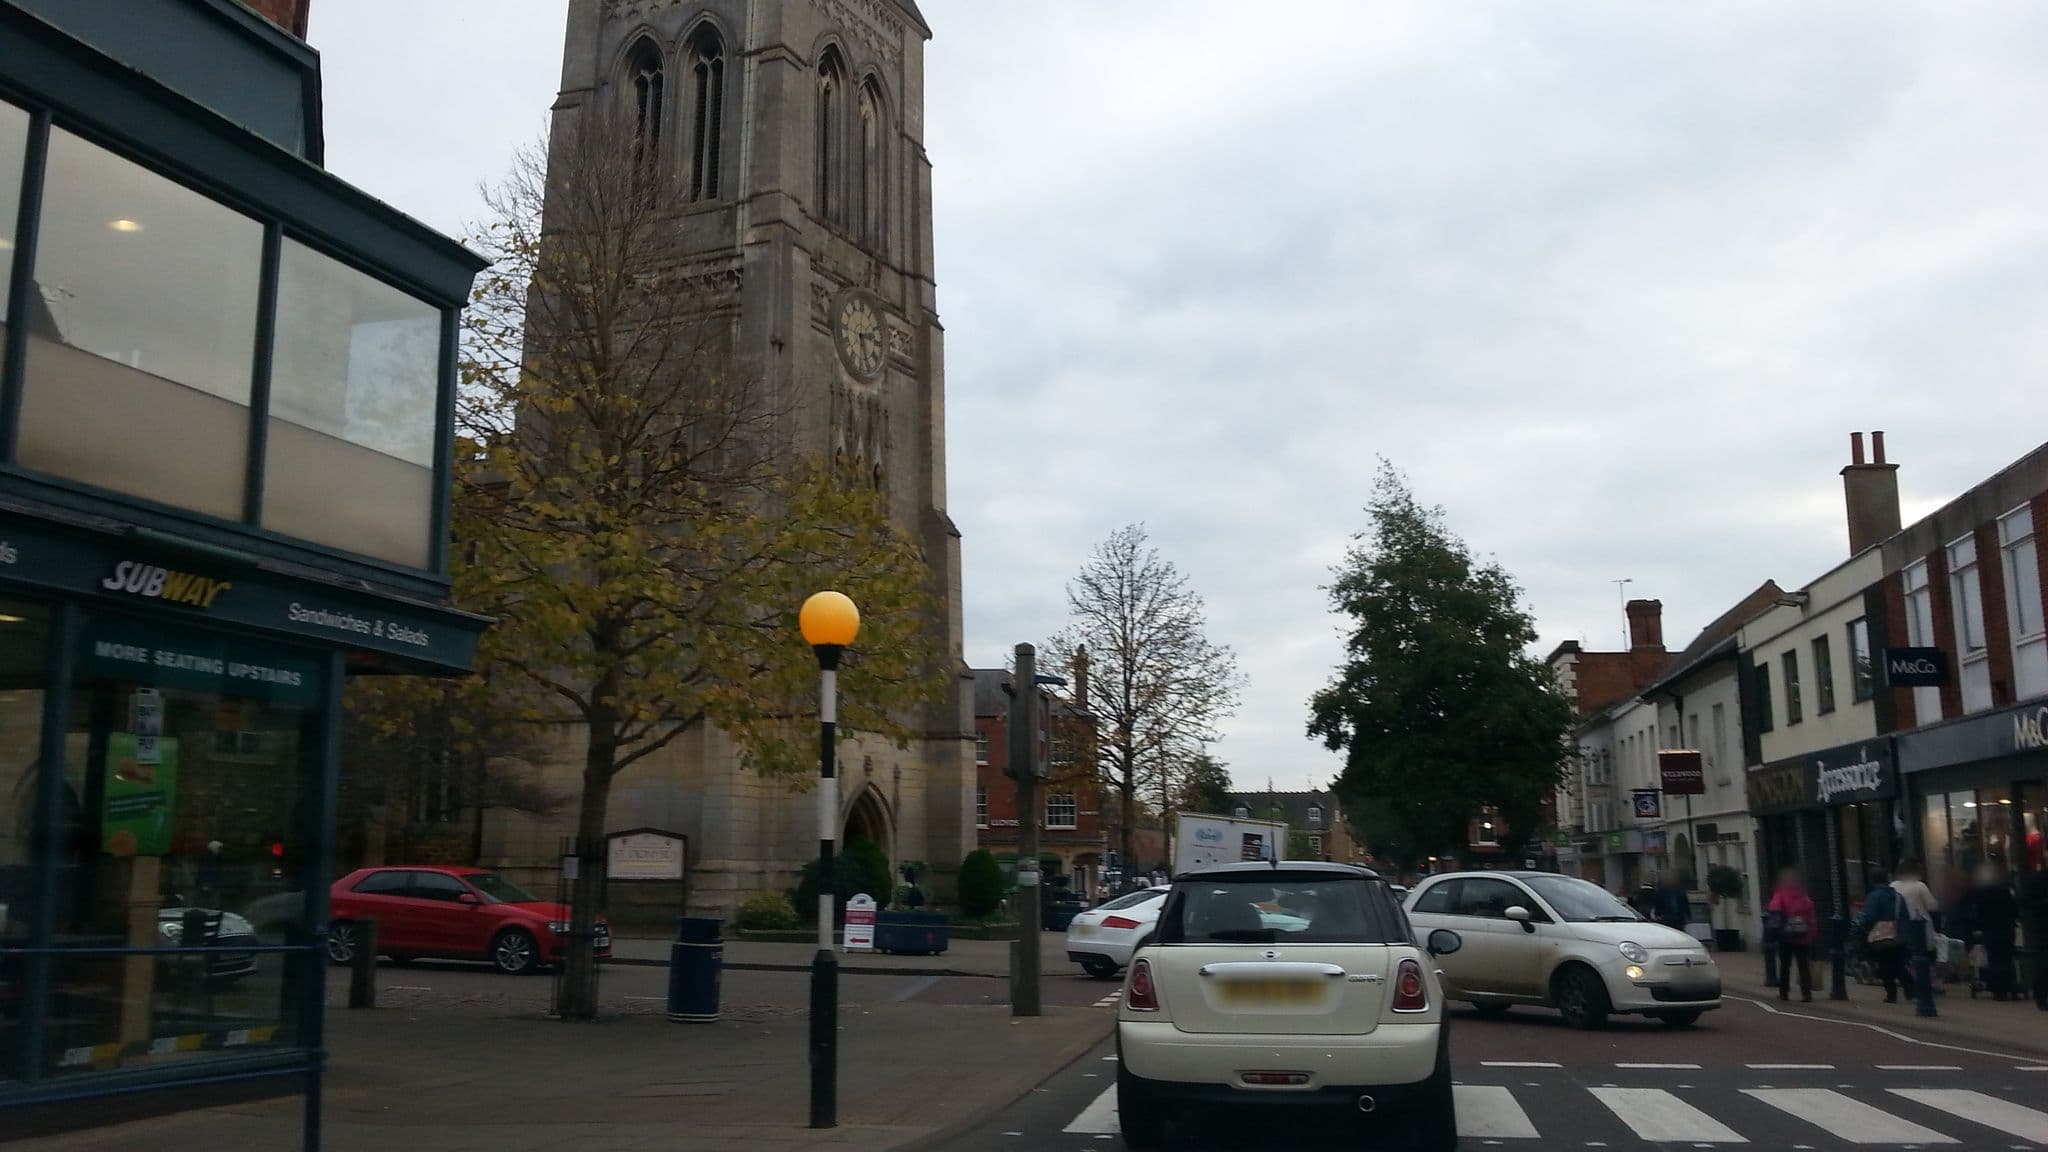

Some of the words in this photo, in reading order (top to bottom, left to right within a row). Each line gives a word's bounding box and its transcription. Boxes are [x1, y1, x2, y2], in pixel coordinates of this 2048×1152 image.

[102, 560, 232, 608] SUBWAY
[287, 602, 371, 634] Sandwiches
[372, 619, 384, 637] &
[387, 622, 430, 646] Salads
[94, 640, 148, 663] MORE
[153, 649, 224, 675] SEATING
[228, 662, 302, 687] UPSTAIRS
